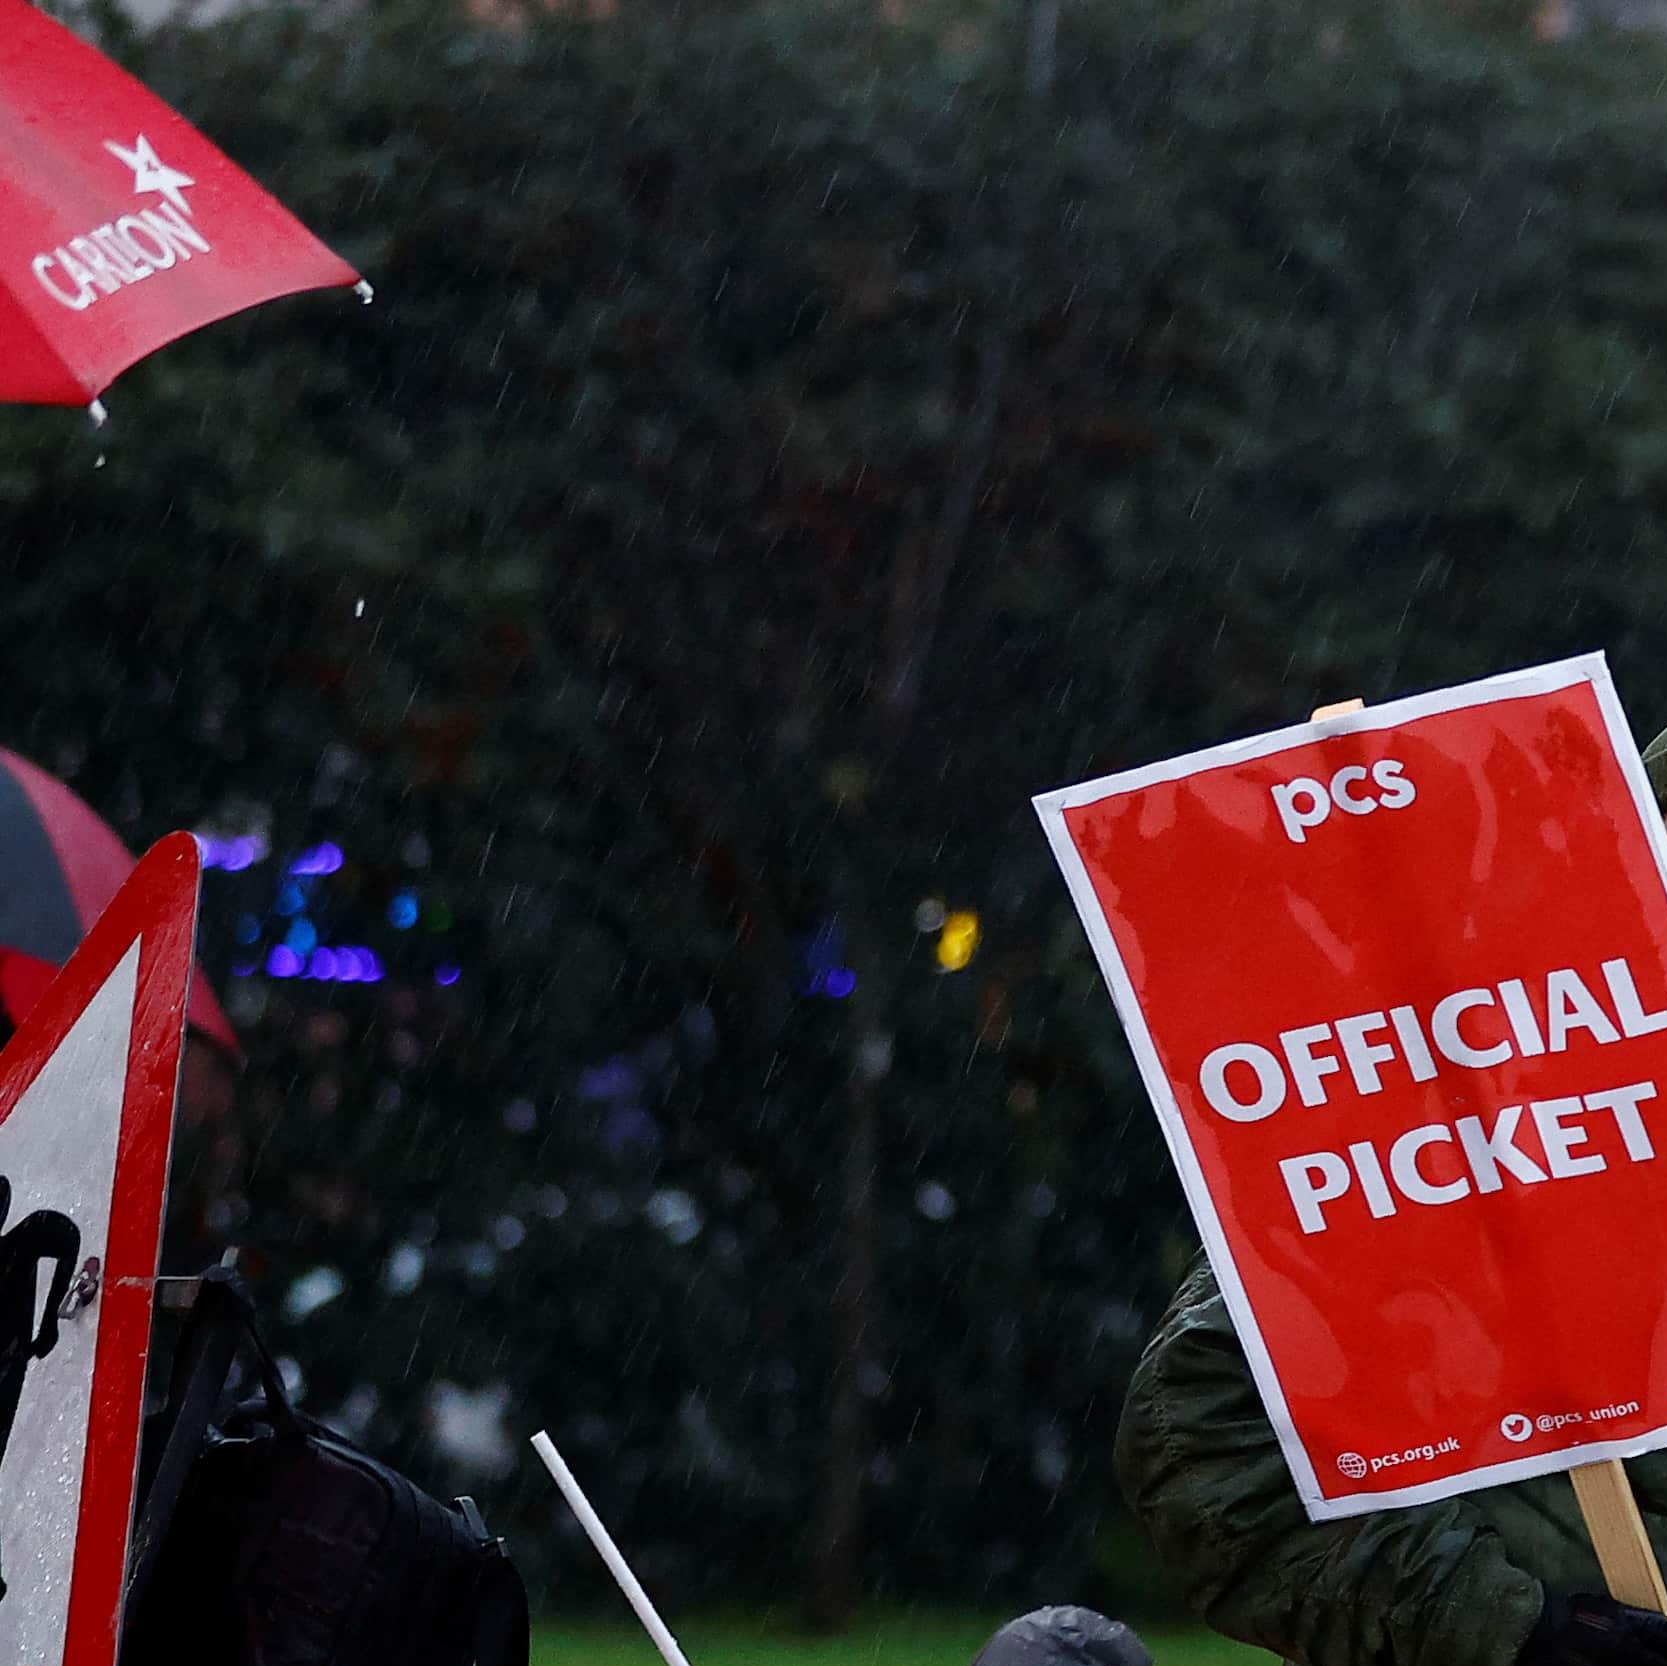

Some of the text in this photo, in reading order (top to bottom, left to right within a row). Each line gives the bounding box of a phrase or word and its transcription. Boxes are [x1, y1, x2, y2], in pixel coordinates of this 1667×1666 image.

[1271, 757, 1417, 843] pcs
[1278, 1082, 1657, 1235] PICKET
[1535, 1400, 1640, 1433] @pcs_union
[1370, 1436, 1461, 1473] pcs.org.uk
